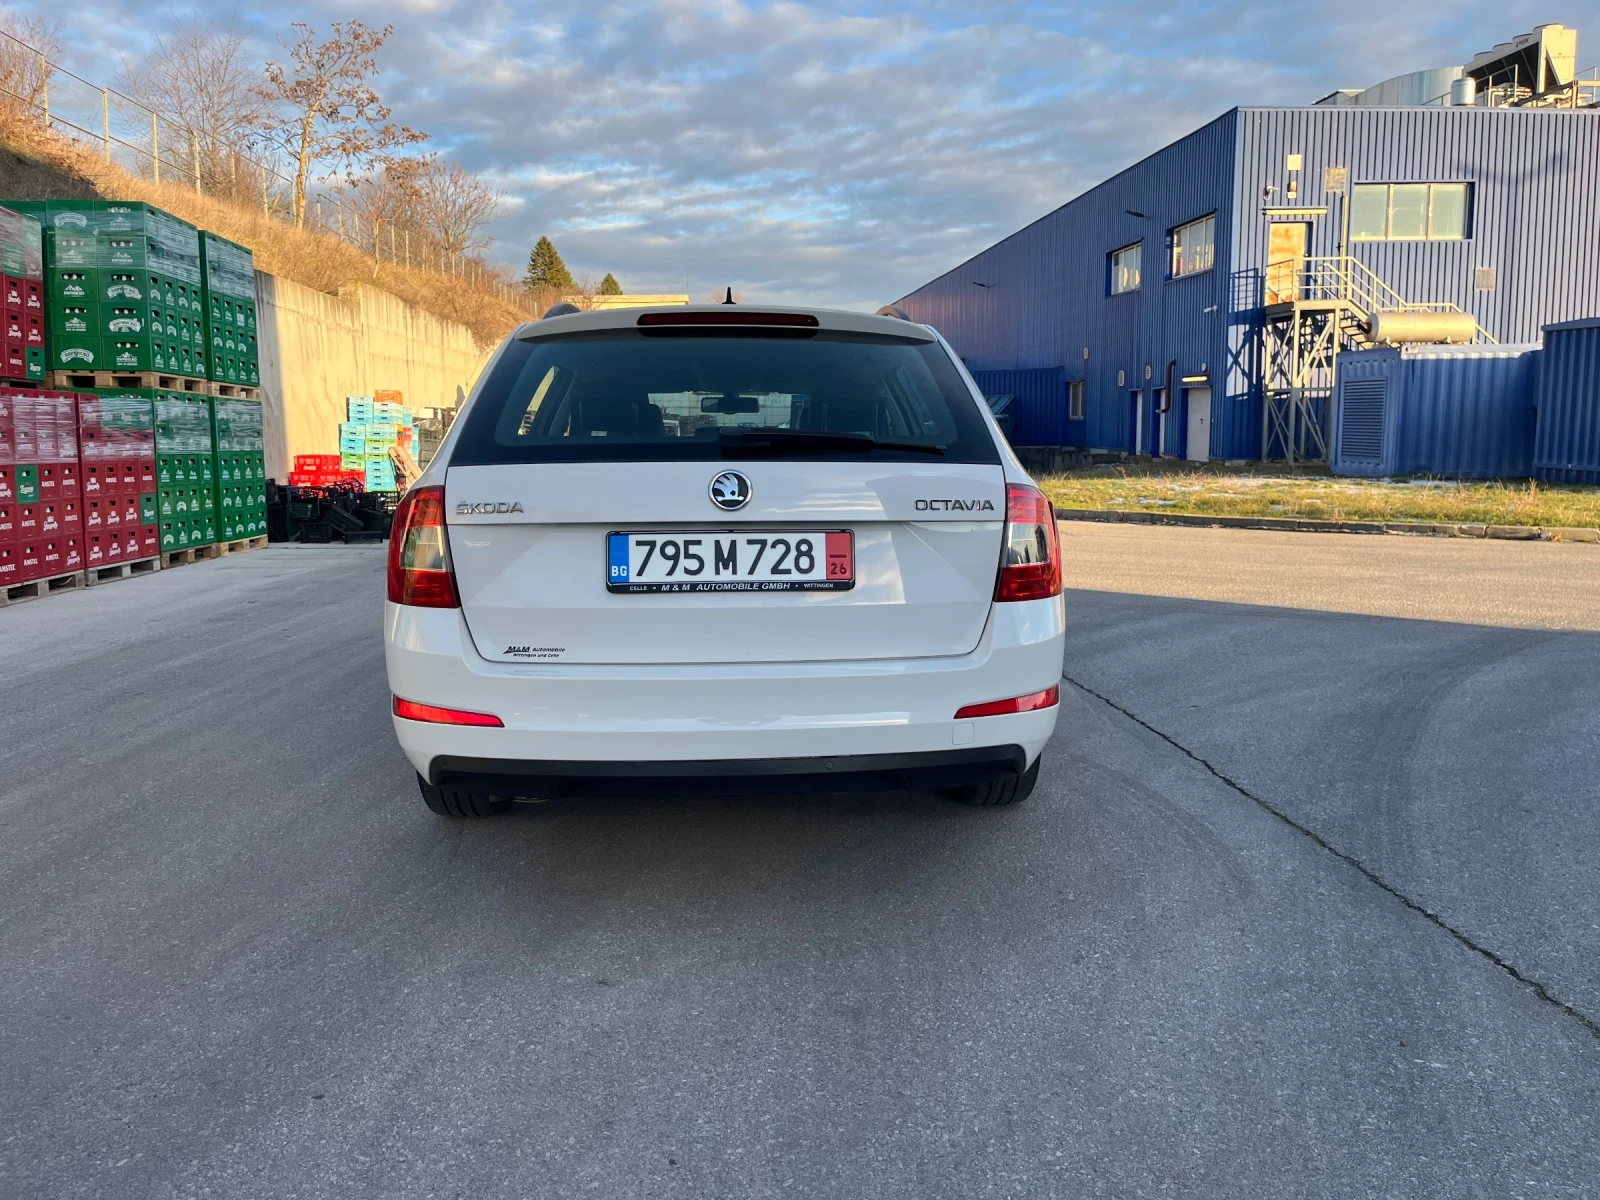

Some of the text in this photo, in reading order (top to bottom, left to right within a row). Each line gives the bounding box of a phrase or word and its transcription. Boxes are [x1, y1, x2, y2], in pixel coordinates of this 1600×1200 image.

[456, 500, 524, 515] ŠKODA
[915, 499, 995, 511] OCTAVIA
[611, 565, 628, 577] BG
[830, 562, 847, 575] 26
[696, 583, 759, 591] AUTOMOBILE
[761, 582, 791, 590] GMBH
